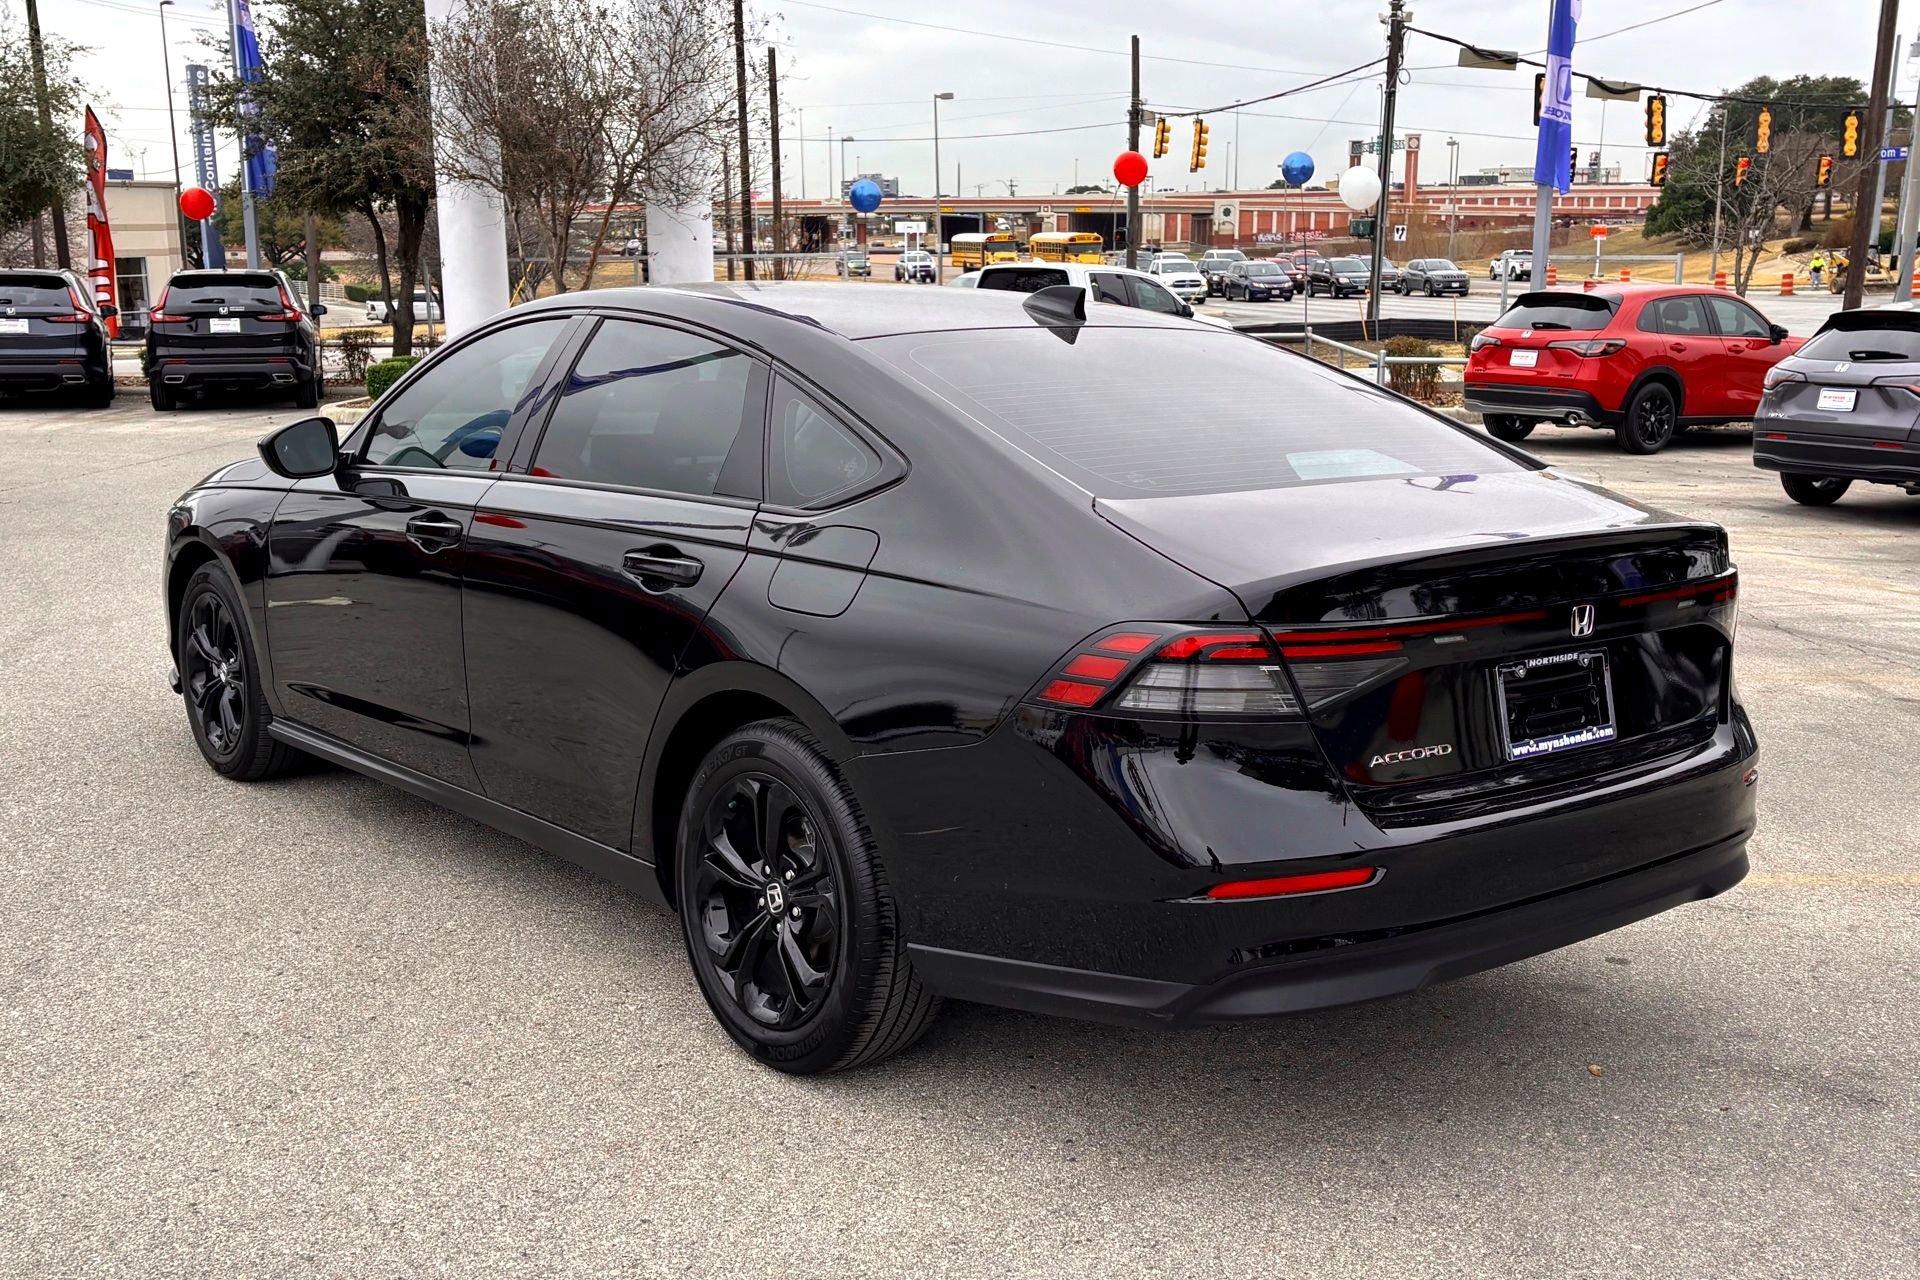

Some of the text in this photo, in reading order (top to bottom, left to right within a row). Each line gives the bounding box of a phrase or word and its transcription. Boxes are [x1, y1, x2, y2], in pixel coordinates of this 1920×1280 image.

[201, 118, 216, 192] Containe
[1880, 149, 1896, 158] om
[1528, 652, 1578, 667] NORTHSIDE
[1512, 727, 1613, 756] www.mynshonda.com
[1369, 744, 1452, 768] ACCORD
